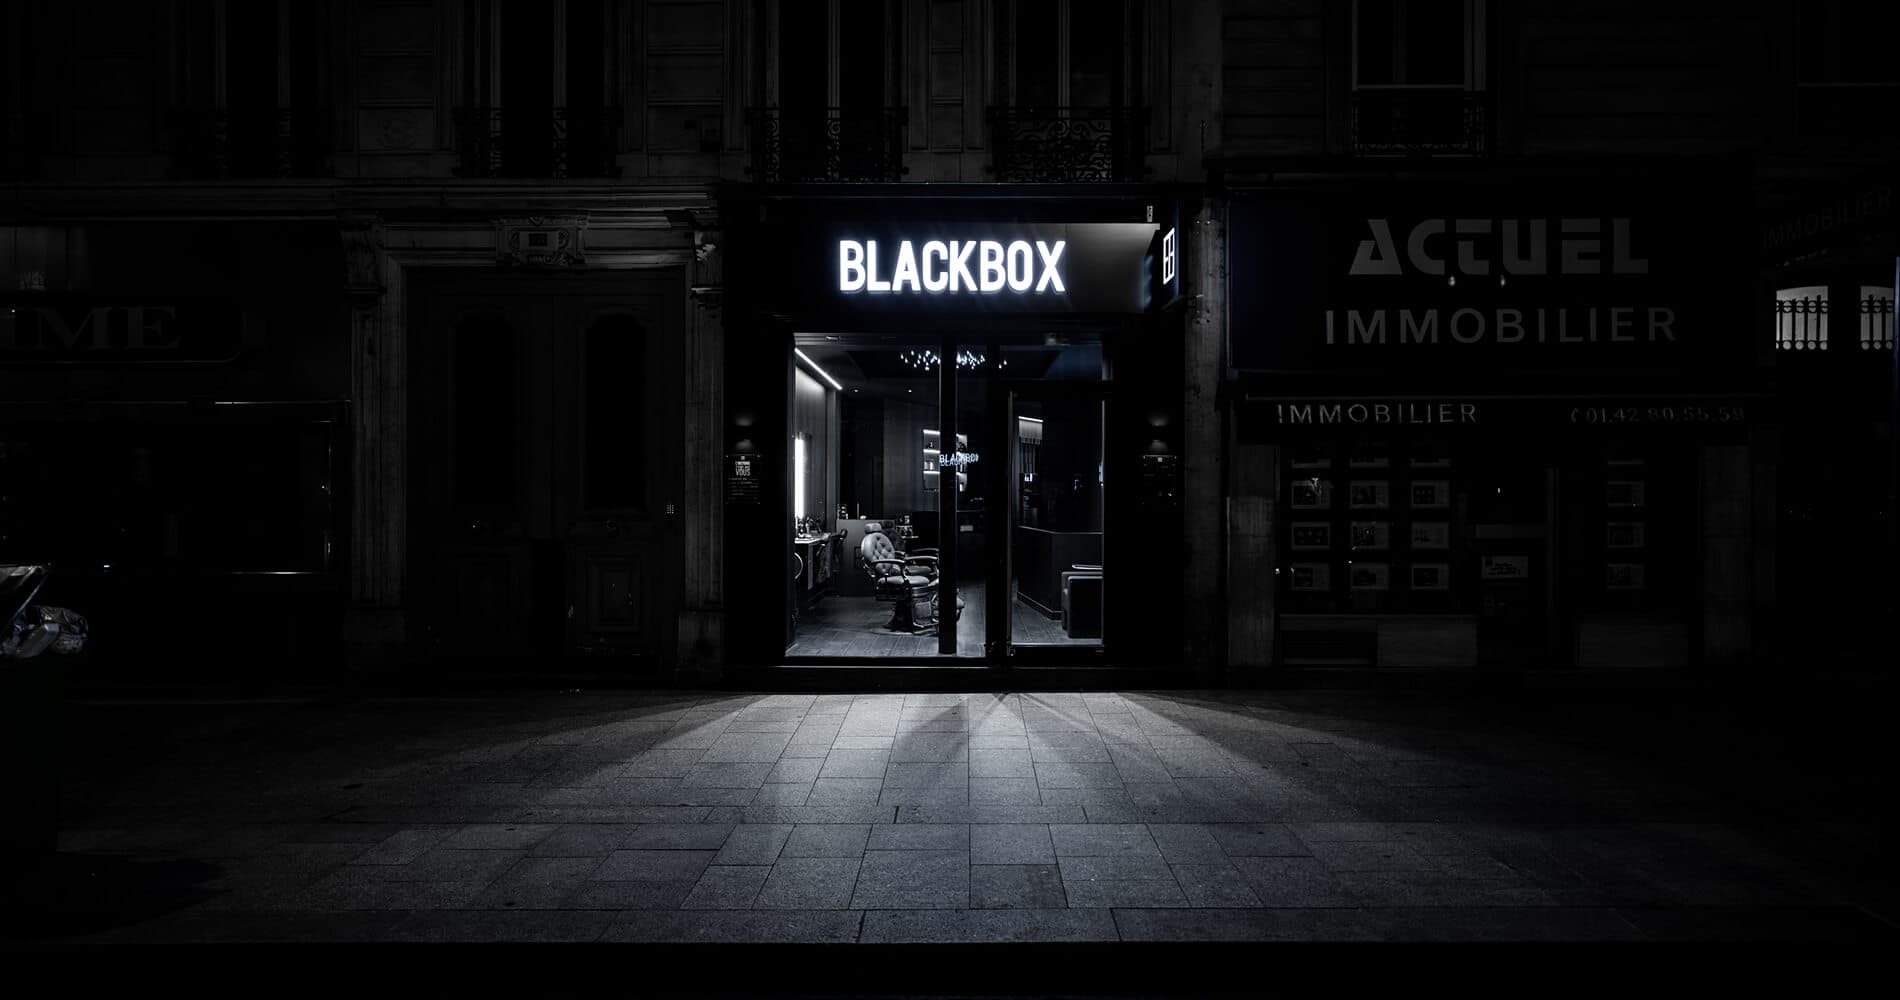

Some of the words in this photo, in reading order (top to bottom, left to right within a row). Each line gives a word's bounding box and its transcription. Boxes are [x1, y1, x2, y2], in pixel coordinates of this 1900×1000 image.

[839, 240, 1067, 292] BLACKBOX
[1349, 217, 1648, 276] ACTUEL
[1325, 306, 1678, 345] IMMOBILIER
[1277, 403, 1477, 424] IMMOBILIER
